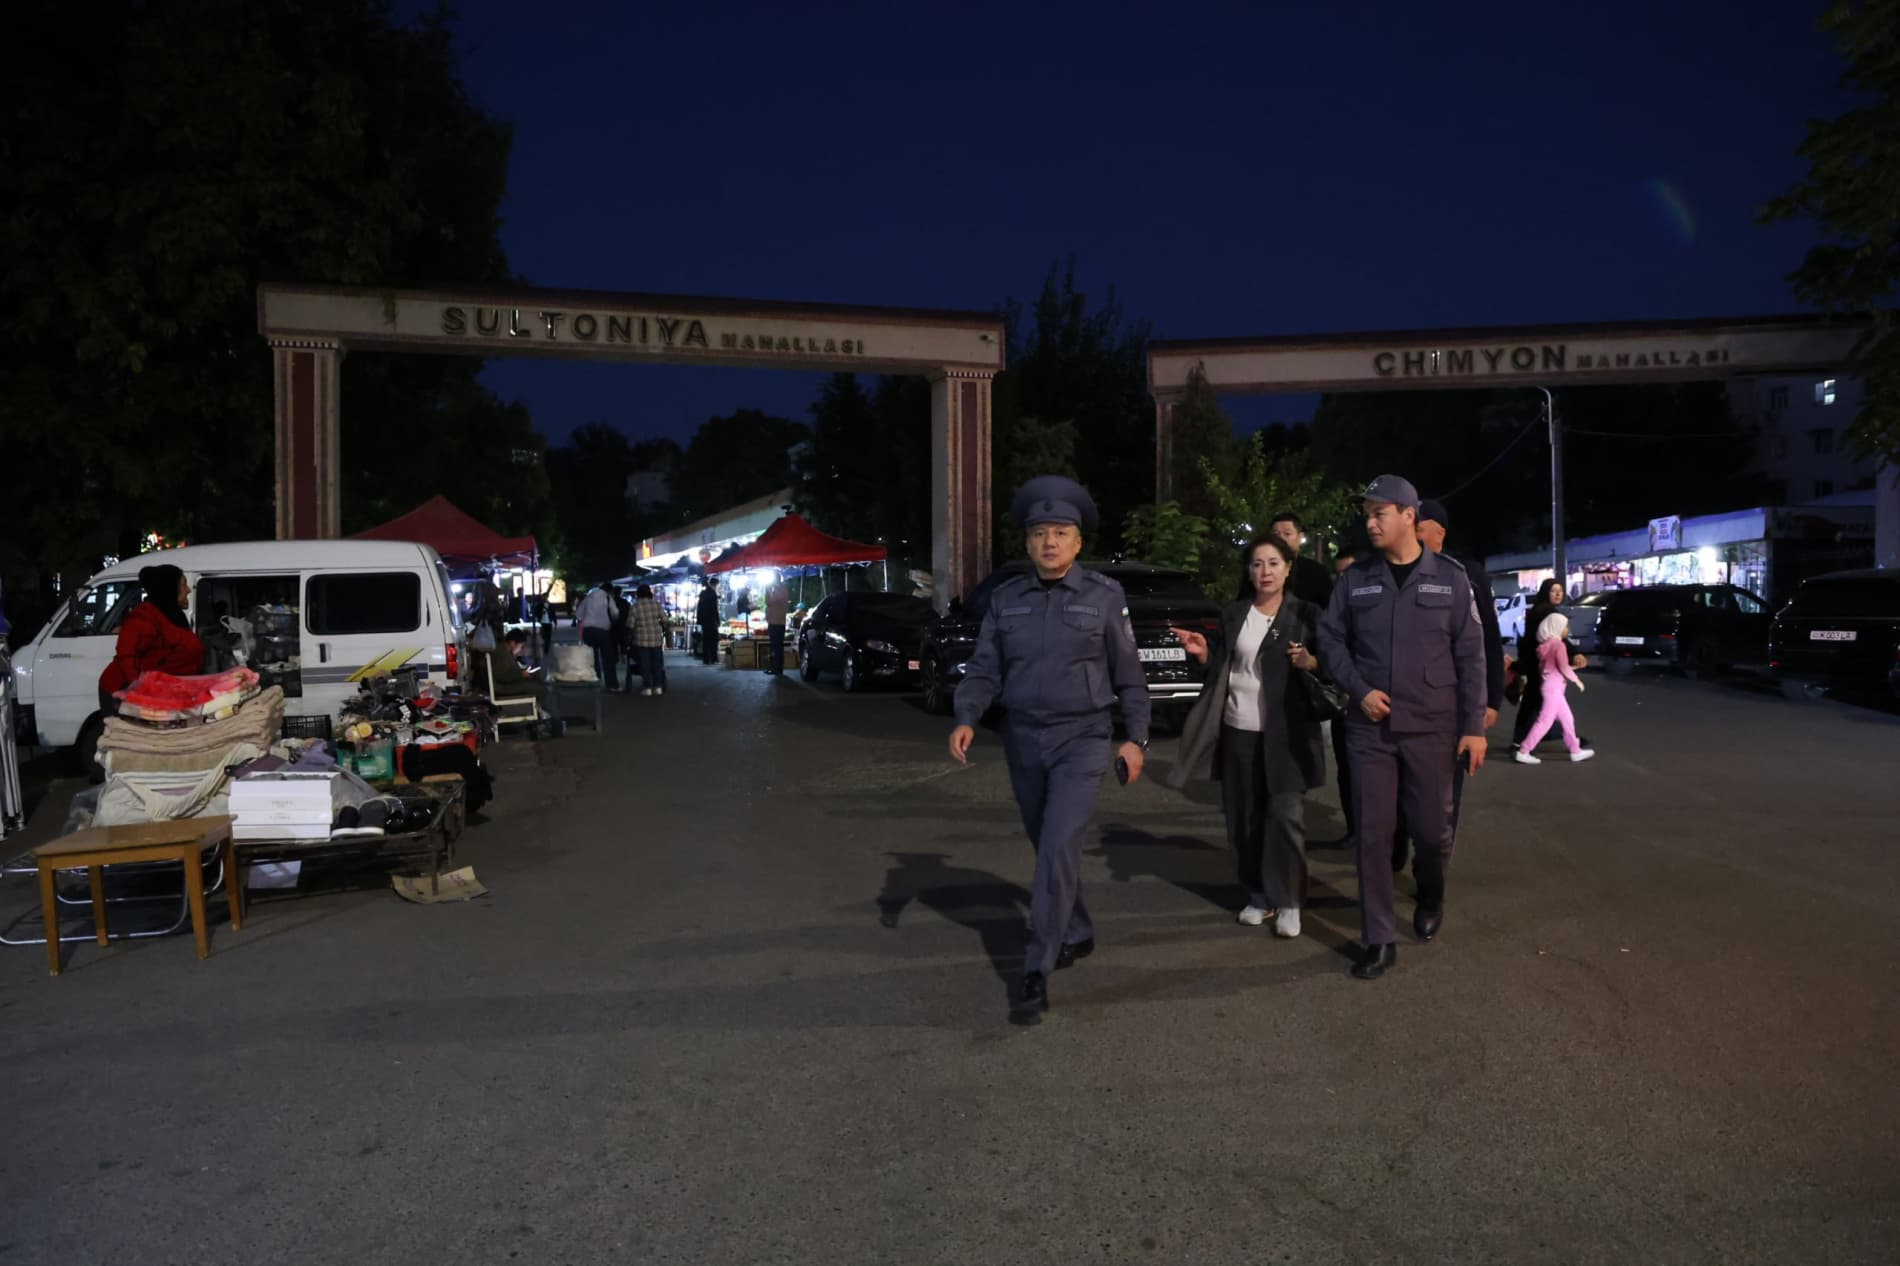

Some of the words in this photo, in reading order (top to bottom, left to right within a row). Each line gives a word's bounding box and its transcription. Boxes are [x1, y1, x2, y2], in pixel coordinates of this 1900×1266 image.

[442, 307, 709, 346] SULTONIYA
[722, 333, 864, 354] MAHALLASI
[1374, 345, 1566, 376] CHIMYON
[1577, 351, 1729, 369] MAHALLASI
